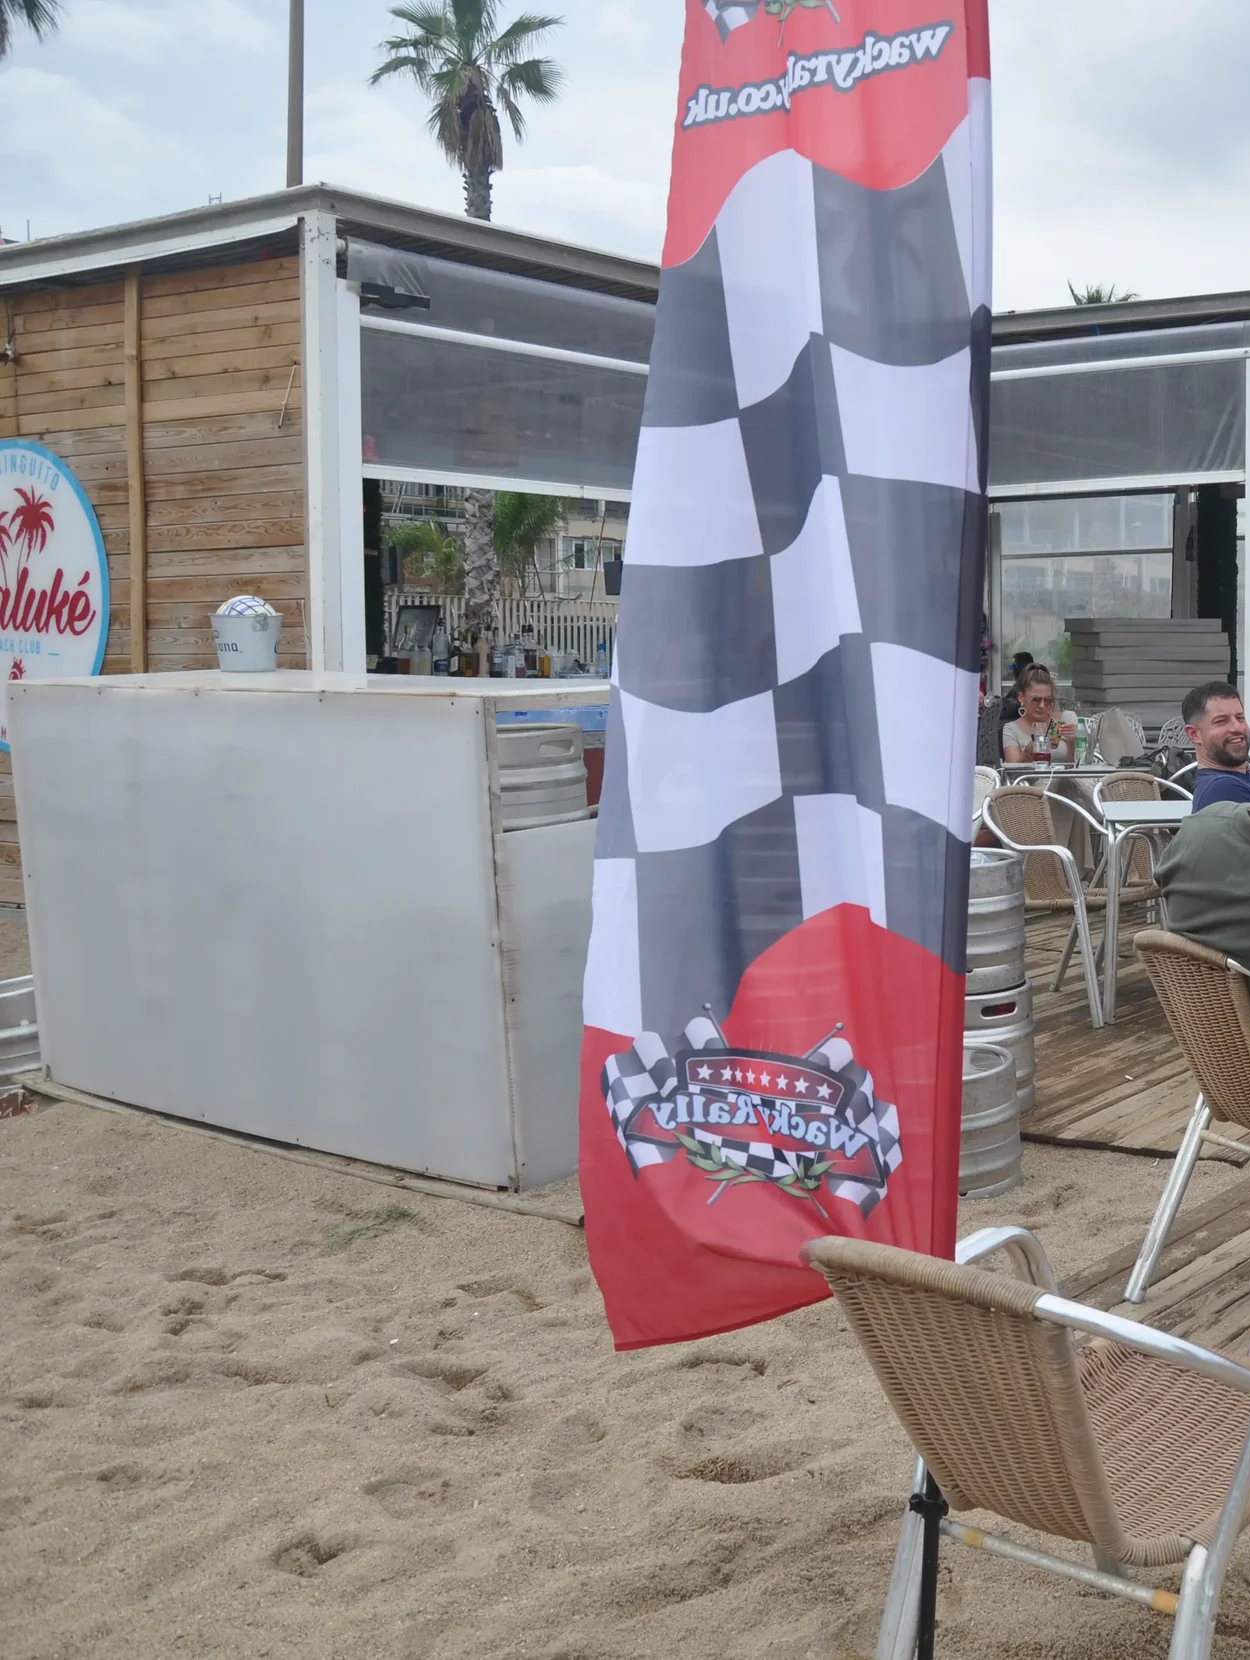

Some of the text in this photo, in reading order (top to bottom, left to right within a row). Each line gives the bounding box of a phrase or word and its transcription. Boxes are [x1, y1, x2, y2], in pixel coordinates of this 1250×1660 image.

[0, 453, 60, 491] INGUITO
[18, 639, 41, 654] CLUB
[217, 642, 239, 652] ona
